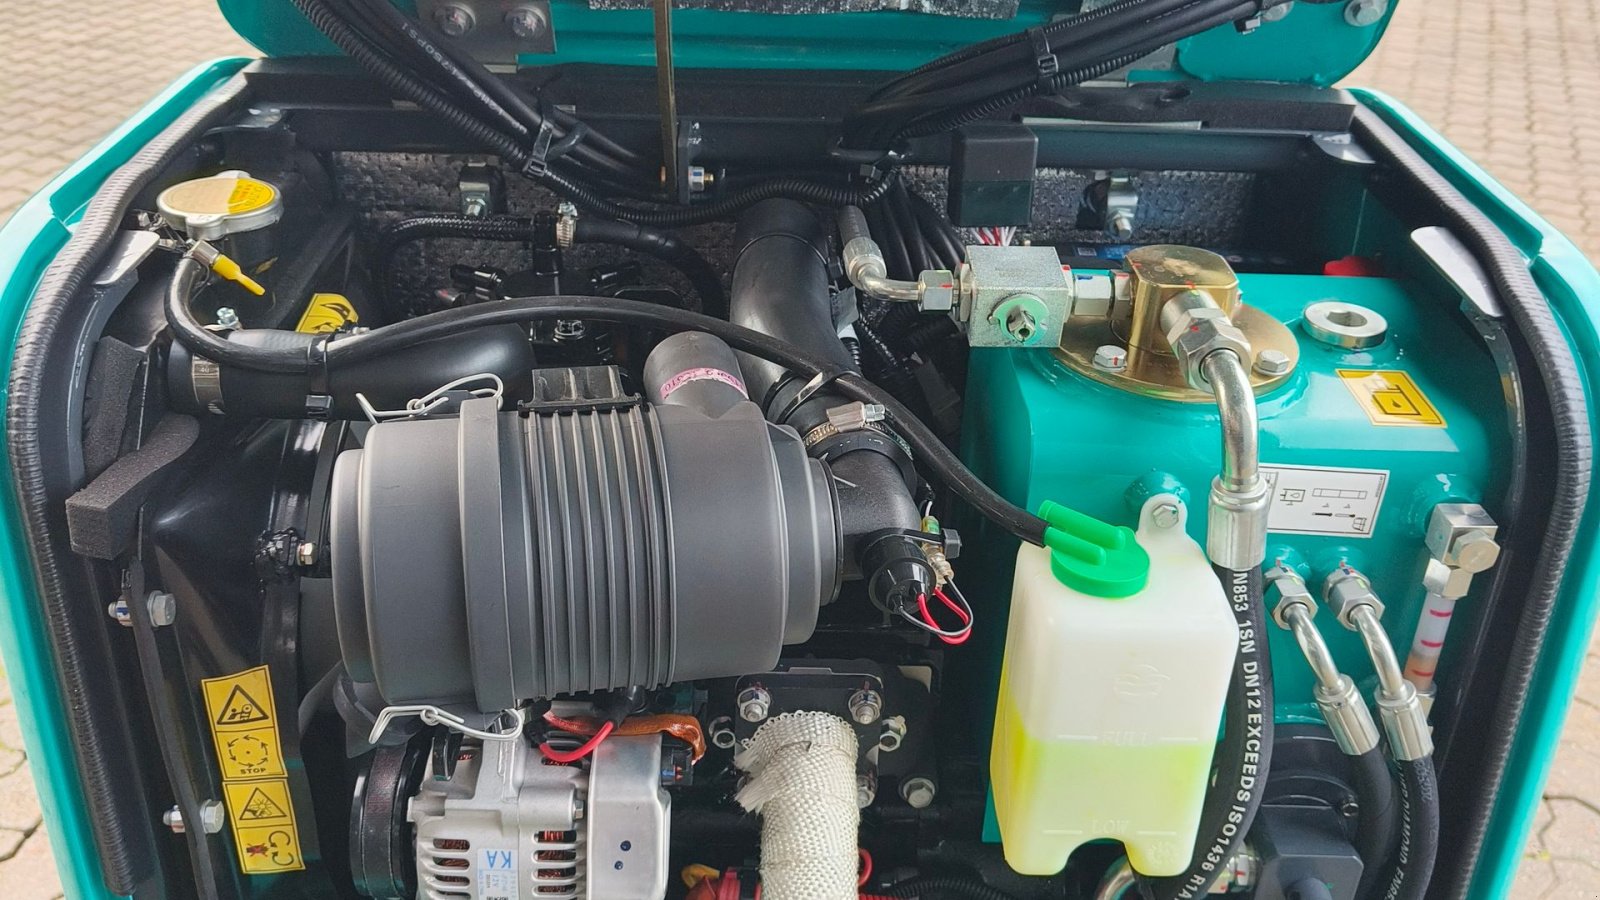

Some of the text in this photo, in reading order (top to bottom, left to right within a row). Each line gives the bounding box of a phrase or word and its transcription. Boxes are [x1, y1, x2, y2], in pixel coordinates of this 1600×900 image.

[1174, 572, 1262, 900] N853 1SN DN12 EXCEEDS ISO1436 R1A
[240, 767, 266, 775] STOP
[486, 850, 512, 869] KA
